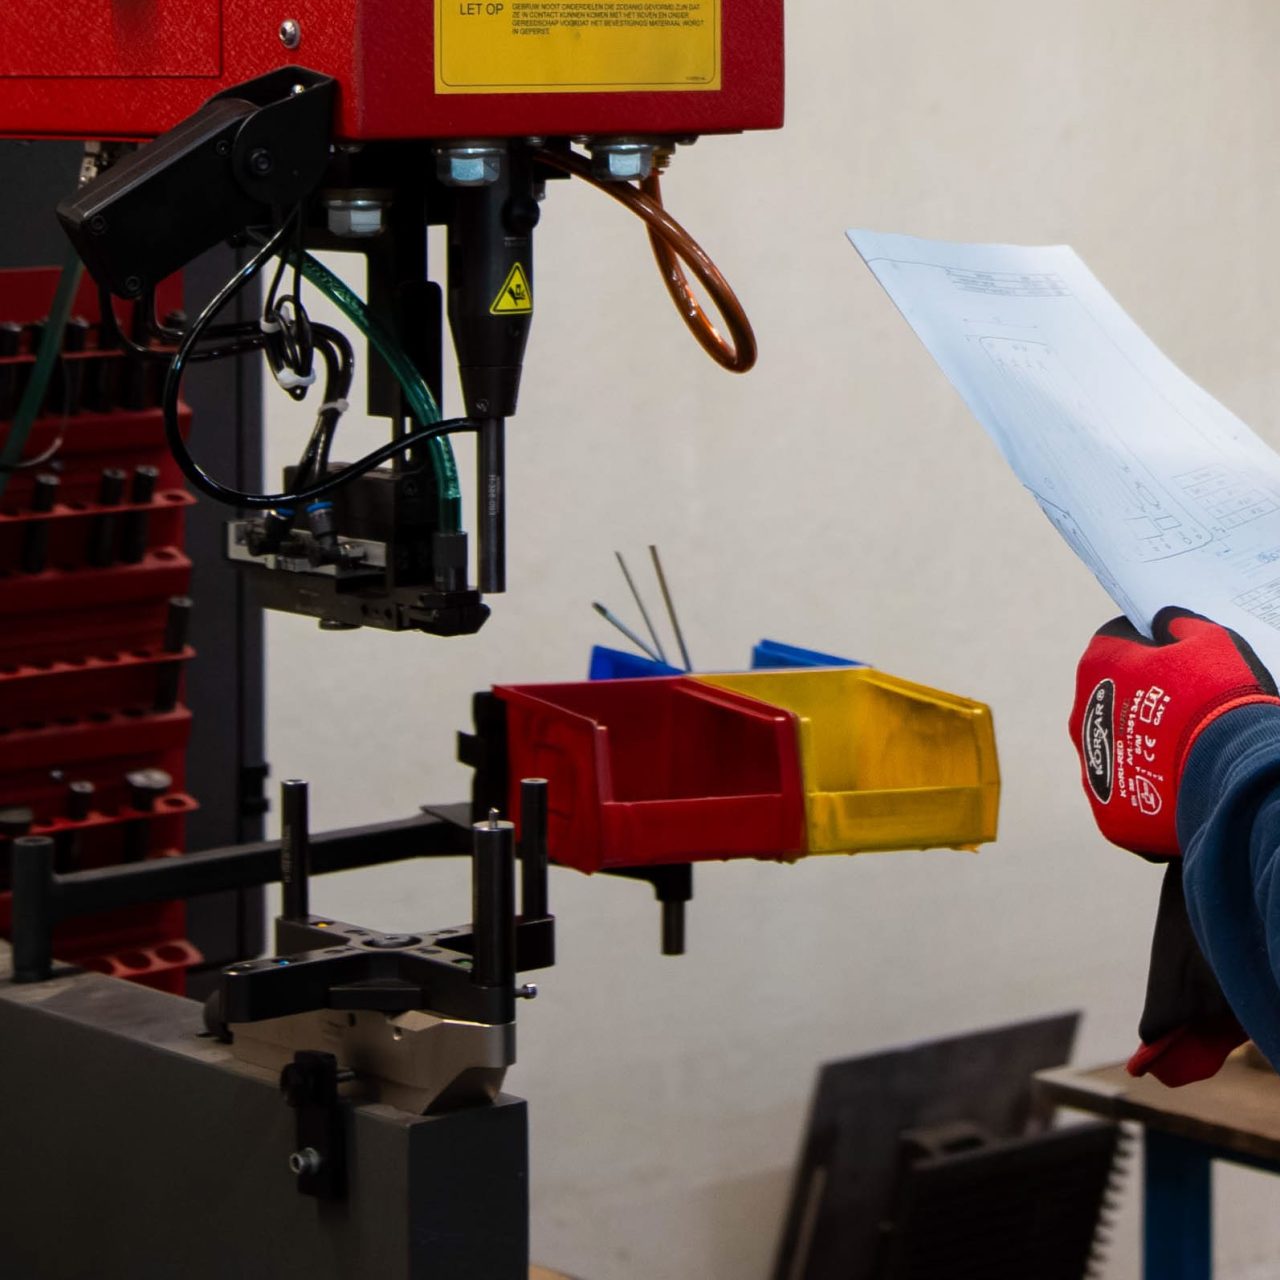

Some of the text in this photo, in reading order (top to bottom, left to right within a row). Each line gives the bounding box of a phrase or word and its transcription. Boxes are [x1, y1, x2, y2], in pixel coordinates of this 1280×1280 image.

[459, 3, 504, 17] LET OP
[1153, 703, 1166, 726] CAT
[1116, 740, 1127, 798] KORI-RED
